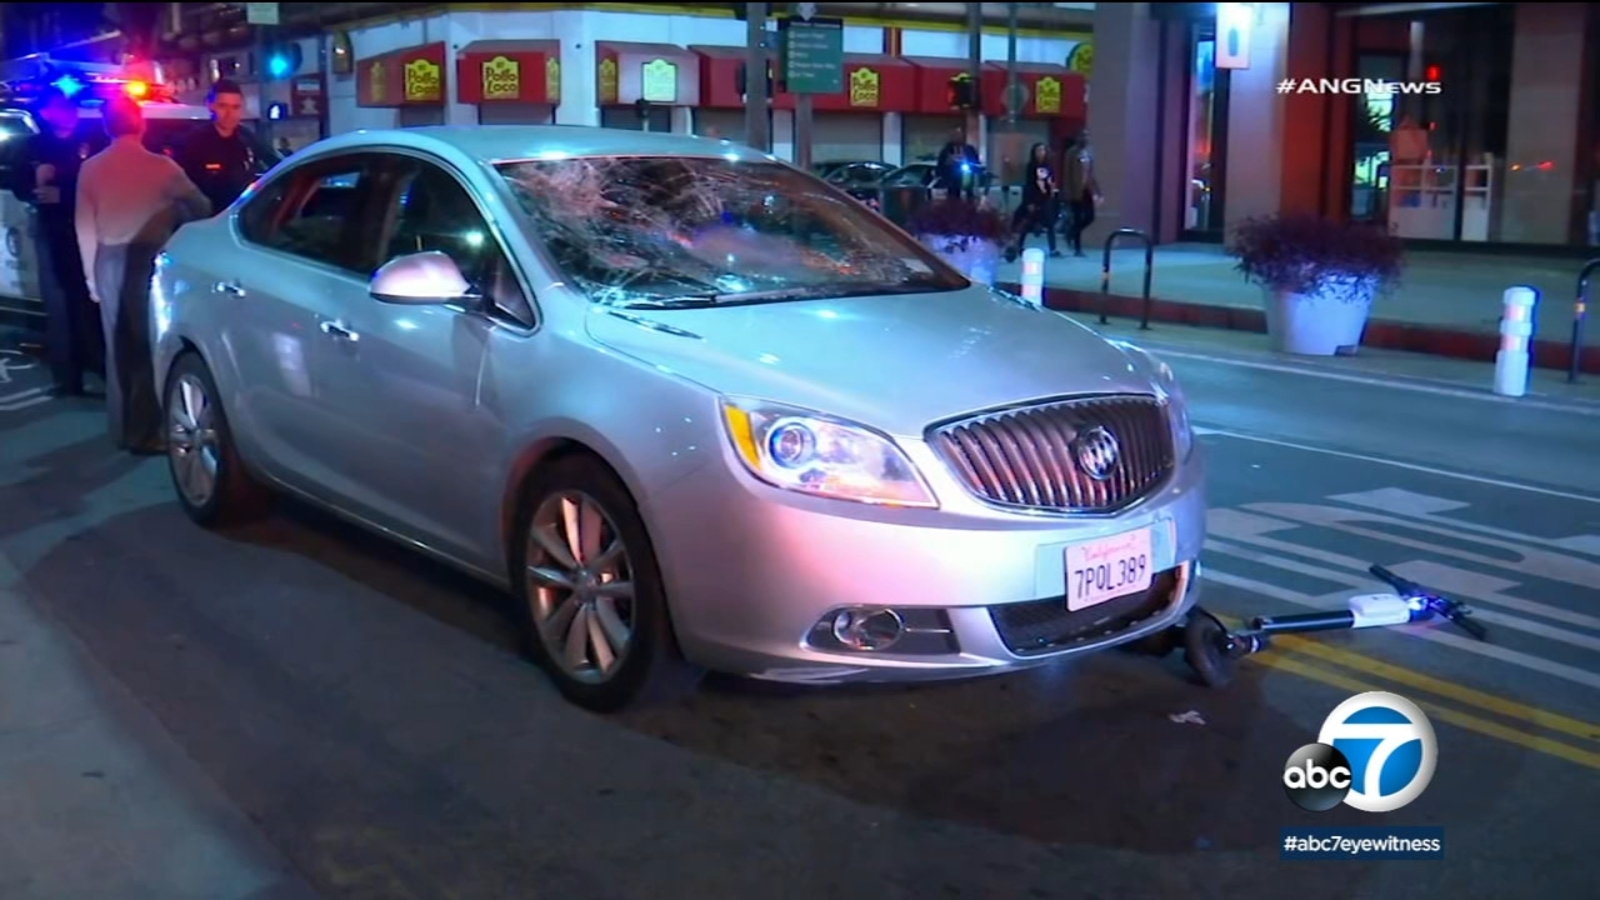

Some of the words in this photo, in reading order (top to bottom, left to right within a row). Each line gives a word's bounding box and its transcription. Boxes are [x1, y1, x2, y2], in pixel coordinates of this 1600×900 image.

[408, 67, 438, 85] Pollo
[486, 66, 517, 82] Pollo
[409, 81, 438, 95] Loco
[487, 80, 517, 95] Loco
